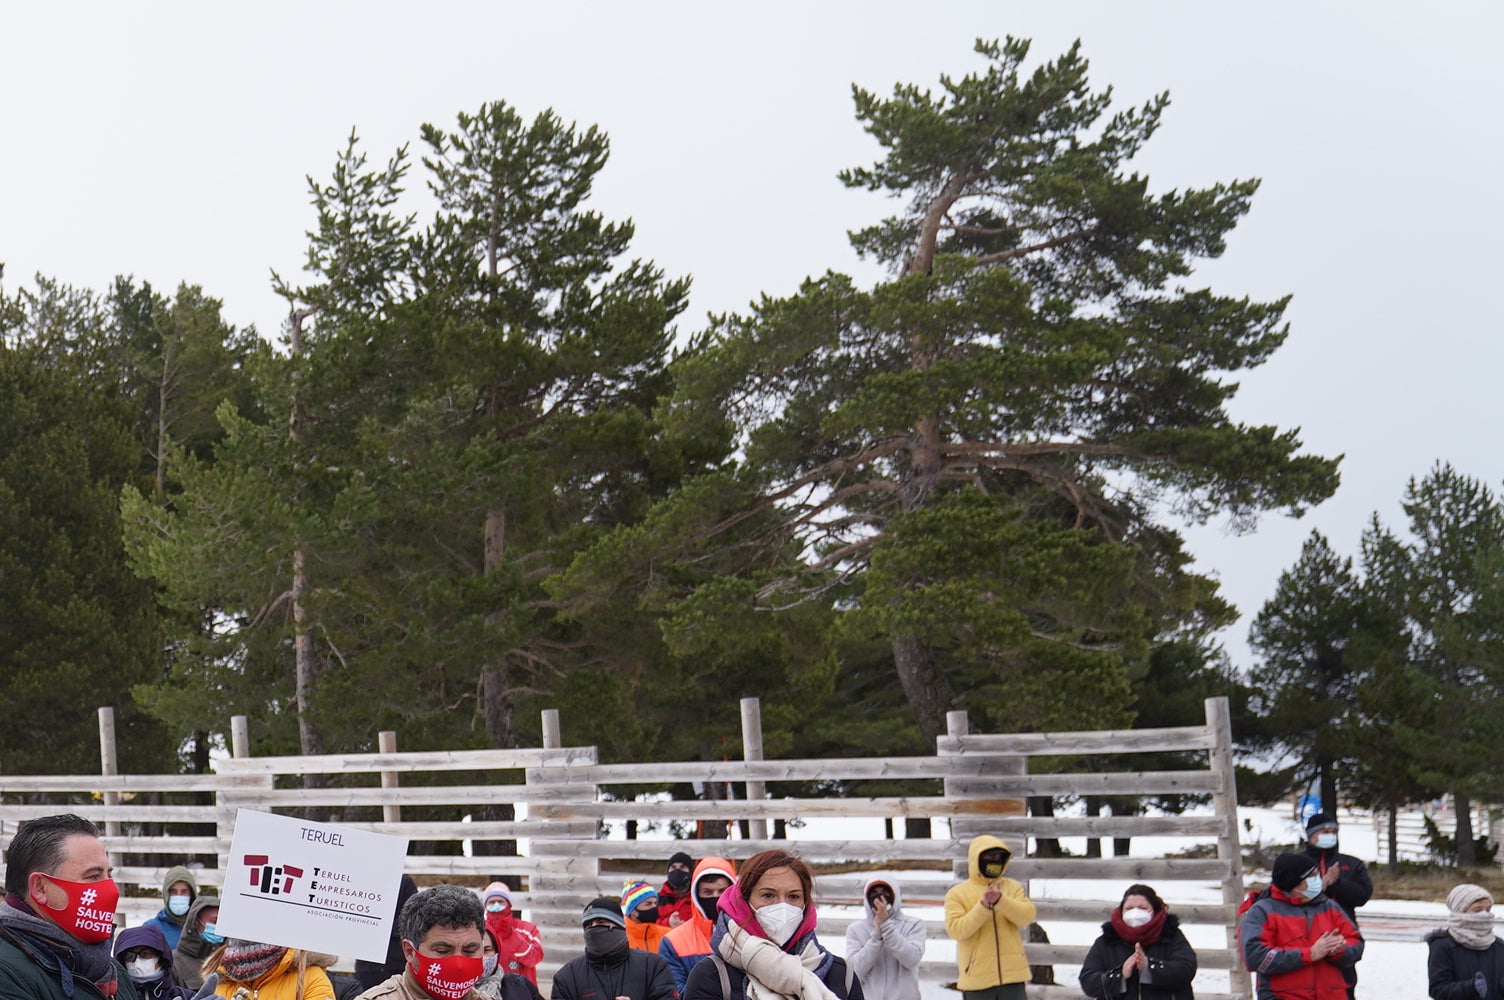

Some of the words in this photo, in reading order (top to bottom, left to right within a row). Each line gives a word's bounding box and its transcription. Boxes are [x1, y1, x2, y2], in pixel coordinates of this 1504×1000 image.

[301, 828, 344, 847] TERUEL
[313, 867, 351, 882] TERUEL
[80, 888, 97, 906] #
[311, 881, 382, 902] EMPRESARIOS
[309, 894, 370, 913] TURISTICOS
[345, 916, 379, 926] PROVINCIAL
[427, 963, 442, 976] #
